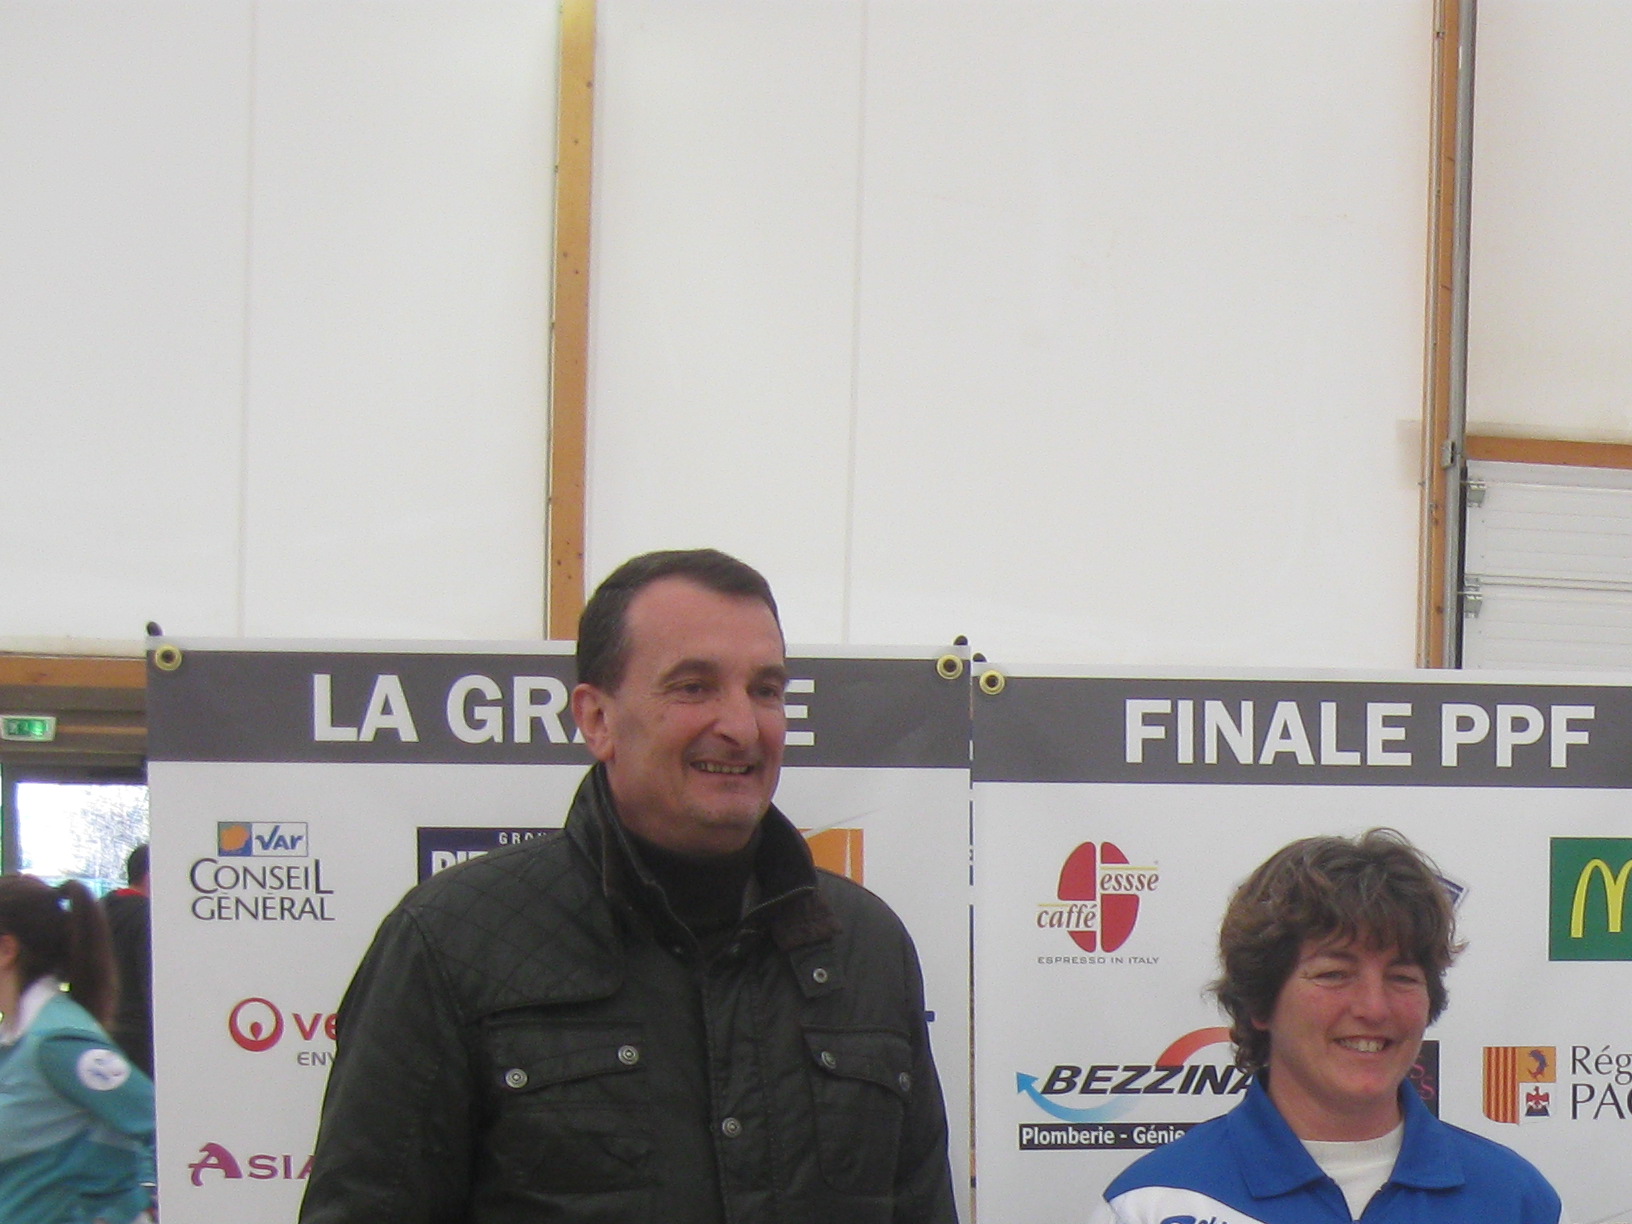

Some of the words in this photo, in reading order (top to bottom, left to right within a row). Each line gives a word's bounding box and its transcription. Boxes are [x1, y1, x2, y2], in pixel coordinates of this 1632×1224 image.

[313, 674, 419, 743] LA
[1125, 698, 1412, 766] FINALE
[1441, 703, 1595, 769] PPF
[190, 857, 334, 895] CONSEIL
[1100, 873, 1160, 892] essse
[1036, 903, 1097, 929] caffé
[1037, 956, 1106, 965] ESPRESSO
[1111, 956, 1124, 964] IN
[1128, 956, 1160, 965] ITALY
[1021, 1125, 1115, 1146] Plomberie
